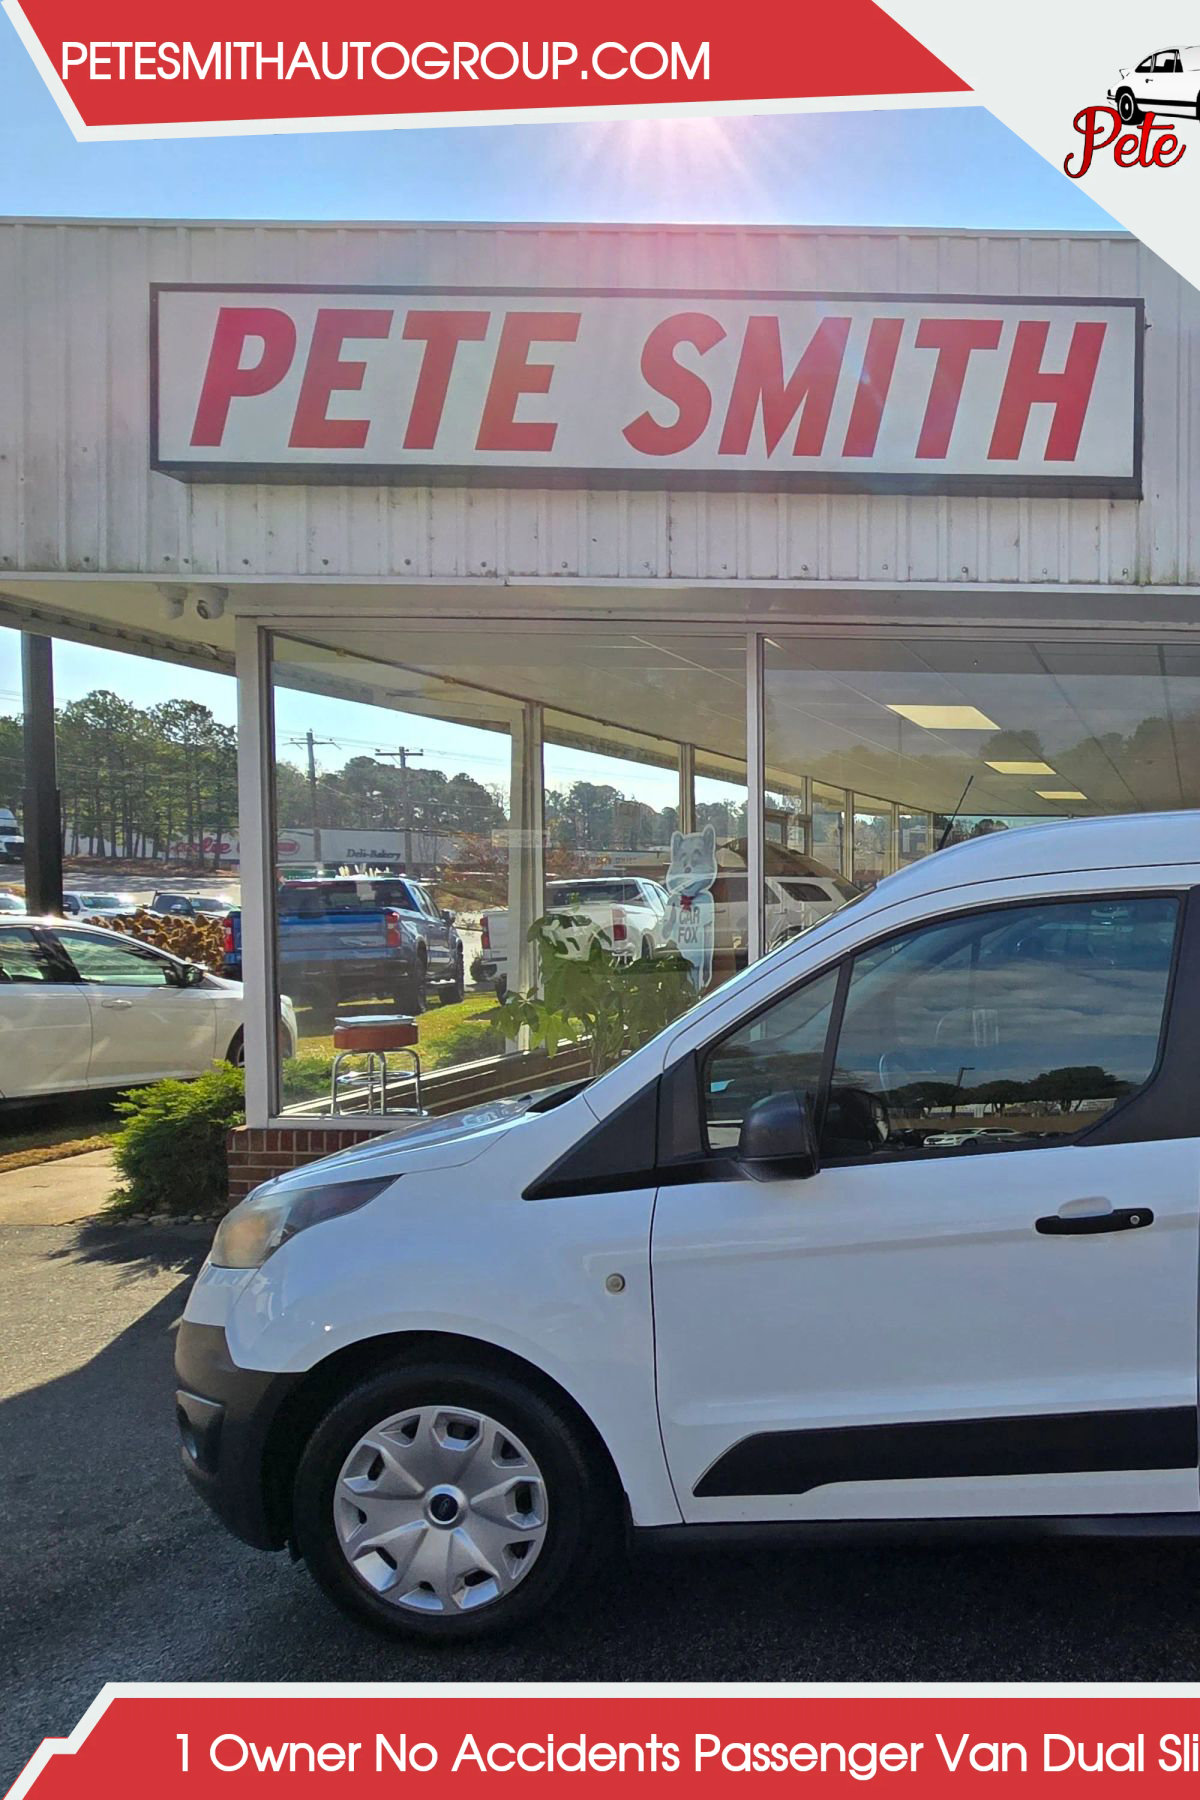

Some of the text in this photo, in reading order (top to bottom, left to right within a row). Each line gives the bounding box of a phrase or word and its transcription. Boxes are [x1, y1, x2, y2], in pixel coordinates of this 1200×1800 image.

[190, 307, 1106, 460] PETE SMITH
[346, 848, 401, 861] Deli-Bakery
[679, 906, 700, 925] CAR
[677, 926, 698, 943] FOX
